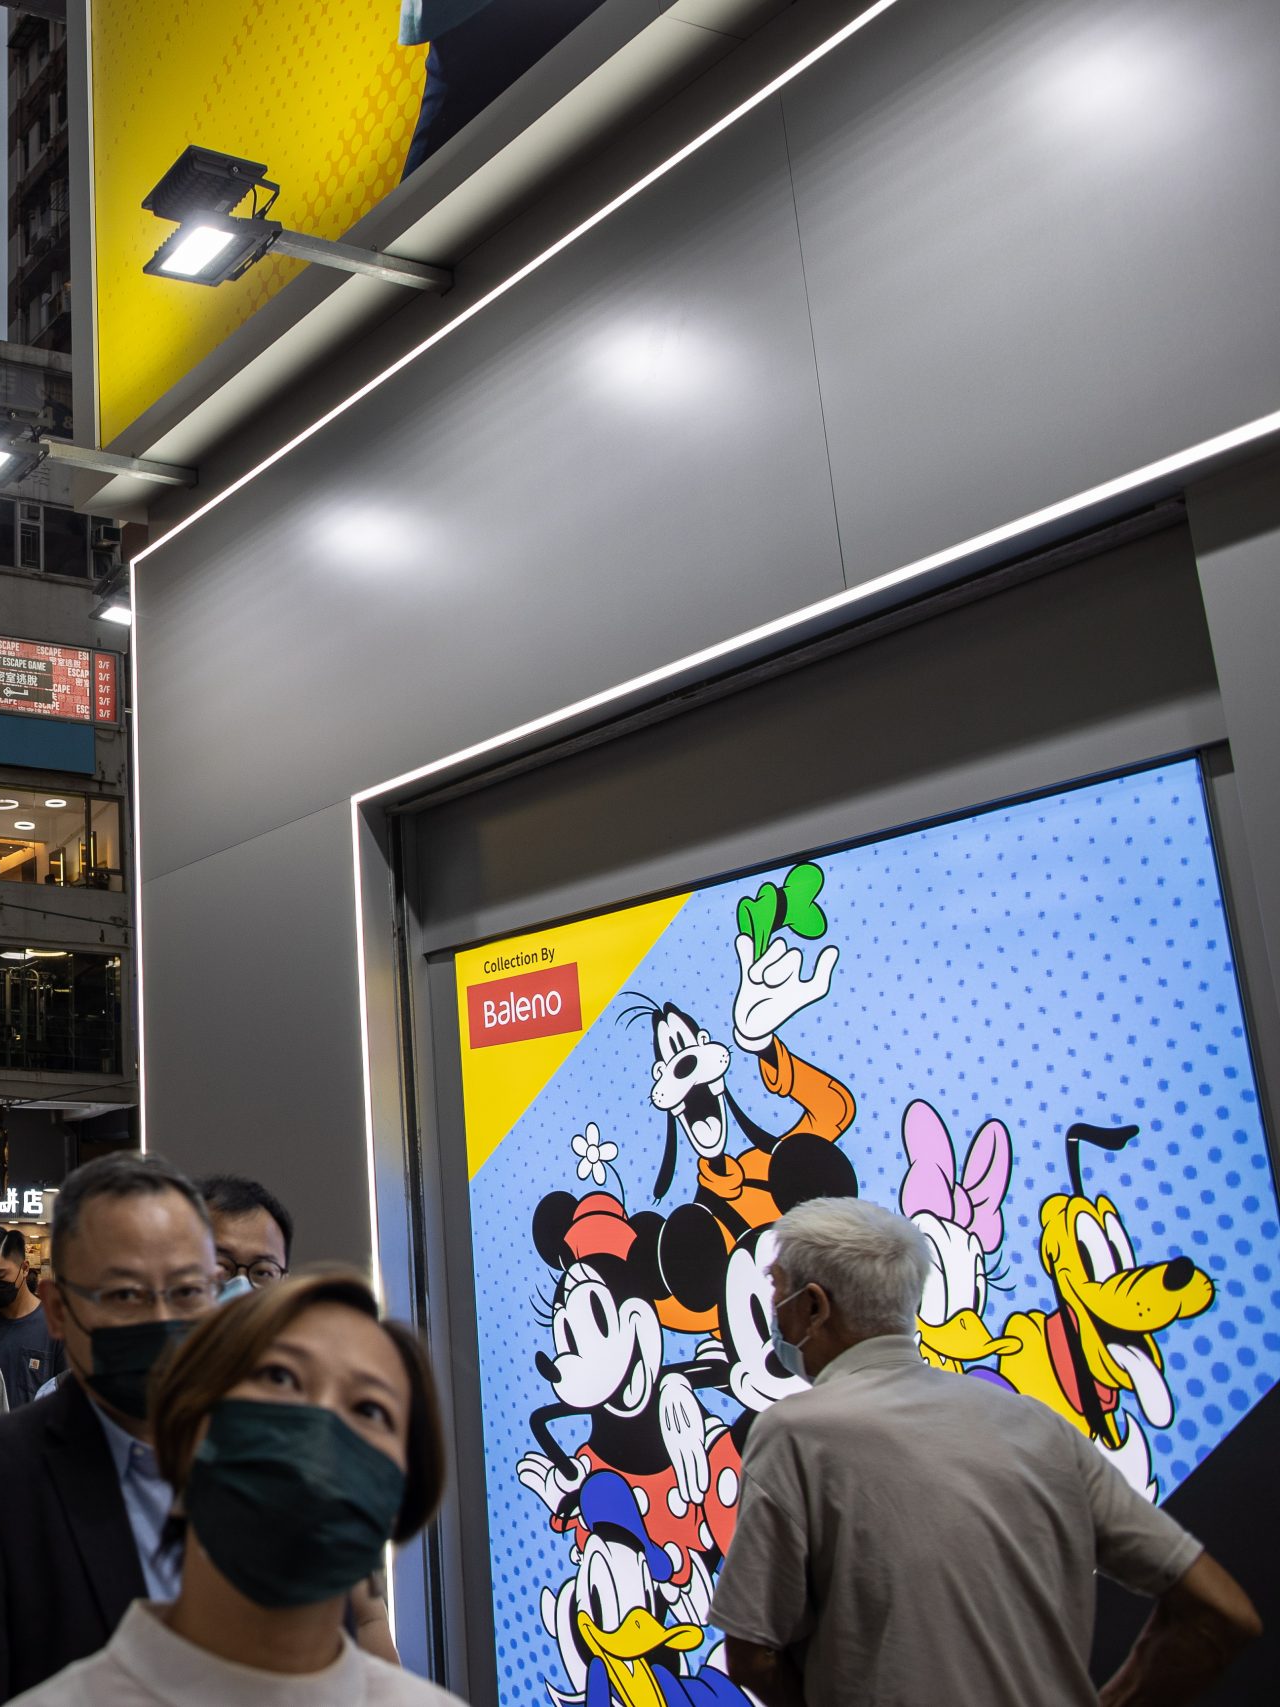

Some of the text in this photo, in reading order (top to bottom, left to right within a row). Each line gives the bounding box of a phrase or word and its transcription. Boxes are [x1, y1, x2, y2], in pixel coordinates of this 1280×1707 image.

[36, 645, 63, 658] ESCAPE
[2, 656, 28, 669] ESCAPE
[28, 660, 47, 672] GAME
[98, 660, 111, 670] 3/F
[98, 672, 111, 682] 3/F
[98, 685, 111, 694] 3/F
[98, 697, 111, 706] 3/F
[98, 709, 111, 719] 3/F
[483, 947, 556, 975] Collection By
[483, 990, 563, 1029] Baleno
